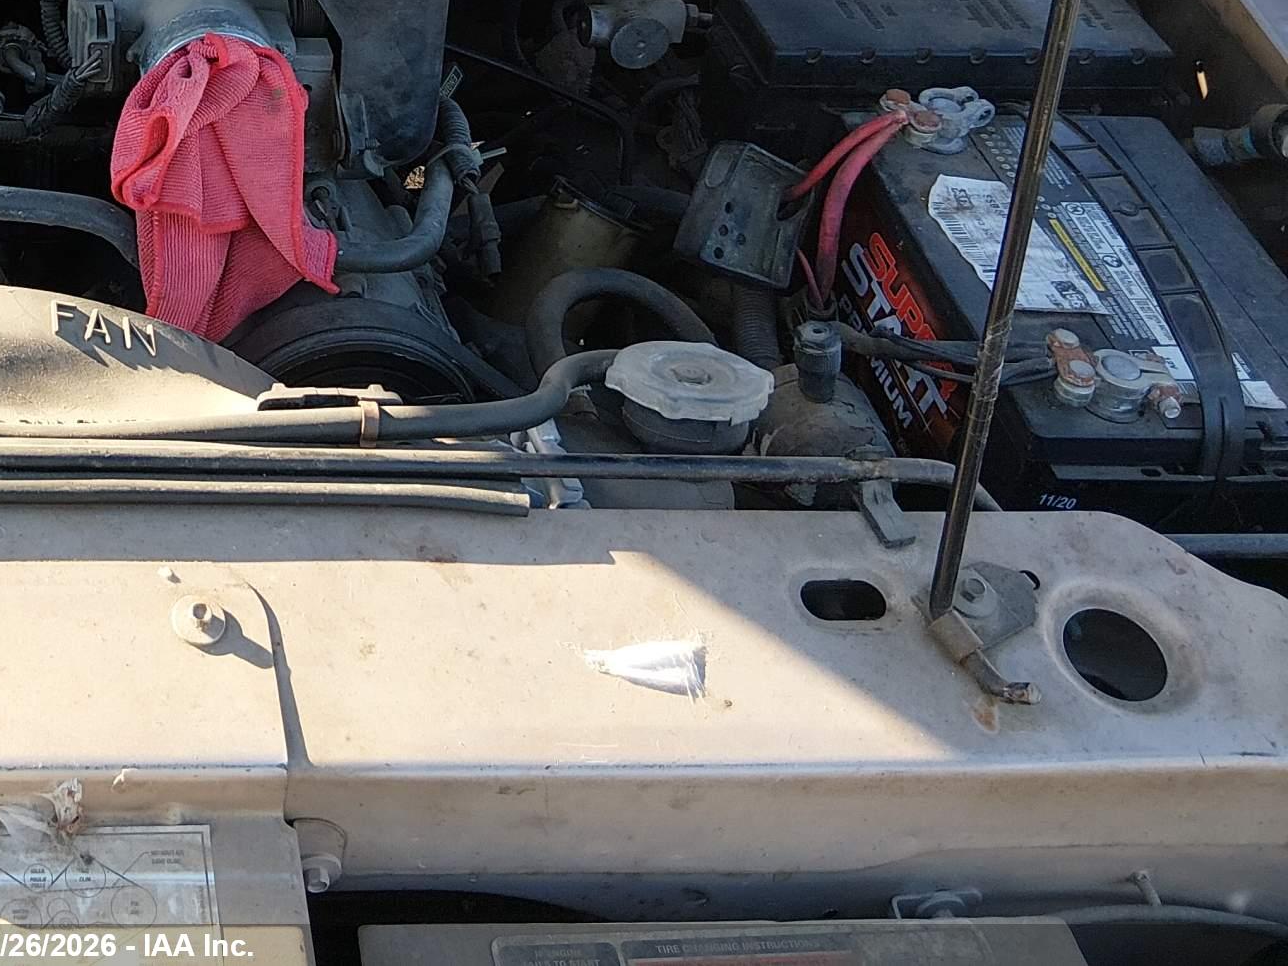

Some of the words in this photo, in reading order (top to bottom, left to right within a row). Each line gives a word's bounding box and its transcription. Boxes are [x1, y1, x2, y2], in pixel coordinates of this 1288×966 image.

[51, 299, 160, 358] FAN
[839, 293, 914, 428] PRMIUM
[1039, 493, 1077, 510] 11/20
[655, 944, 681, 954] TIRE
[682, 941, 741, 953] CHANGING
[742, 938, 821, 951] INSTRUCTIONS
